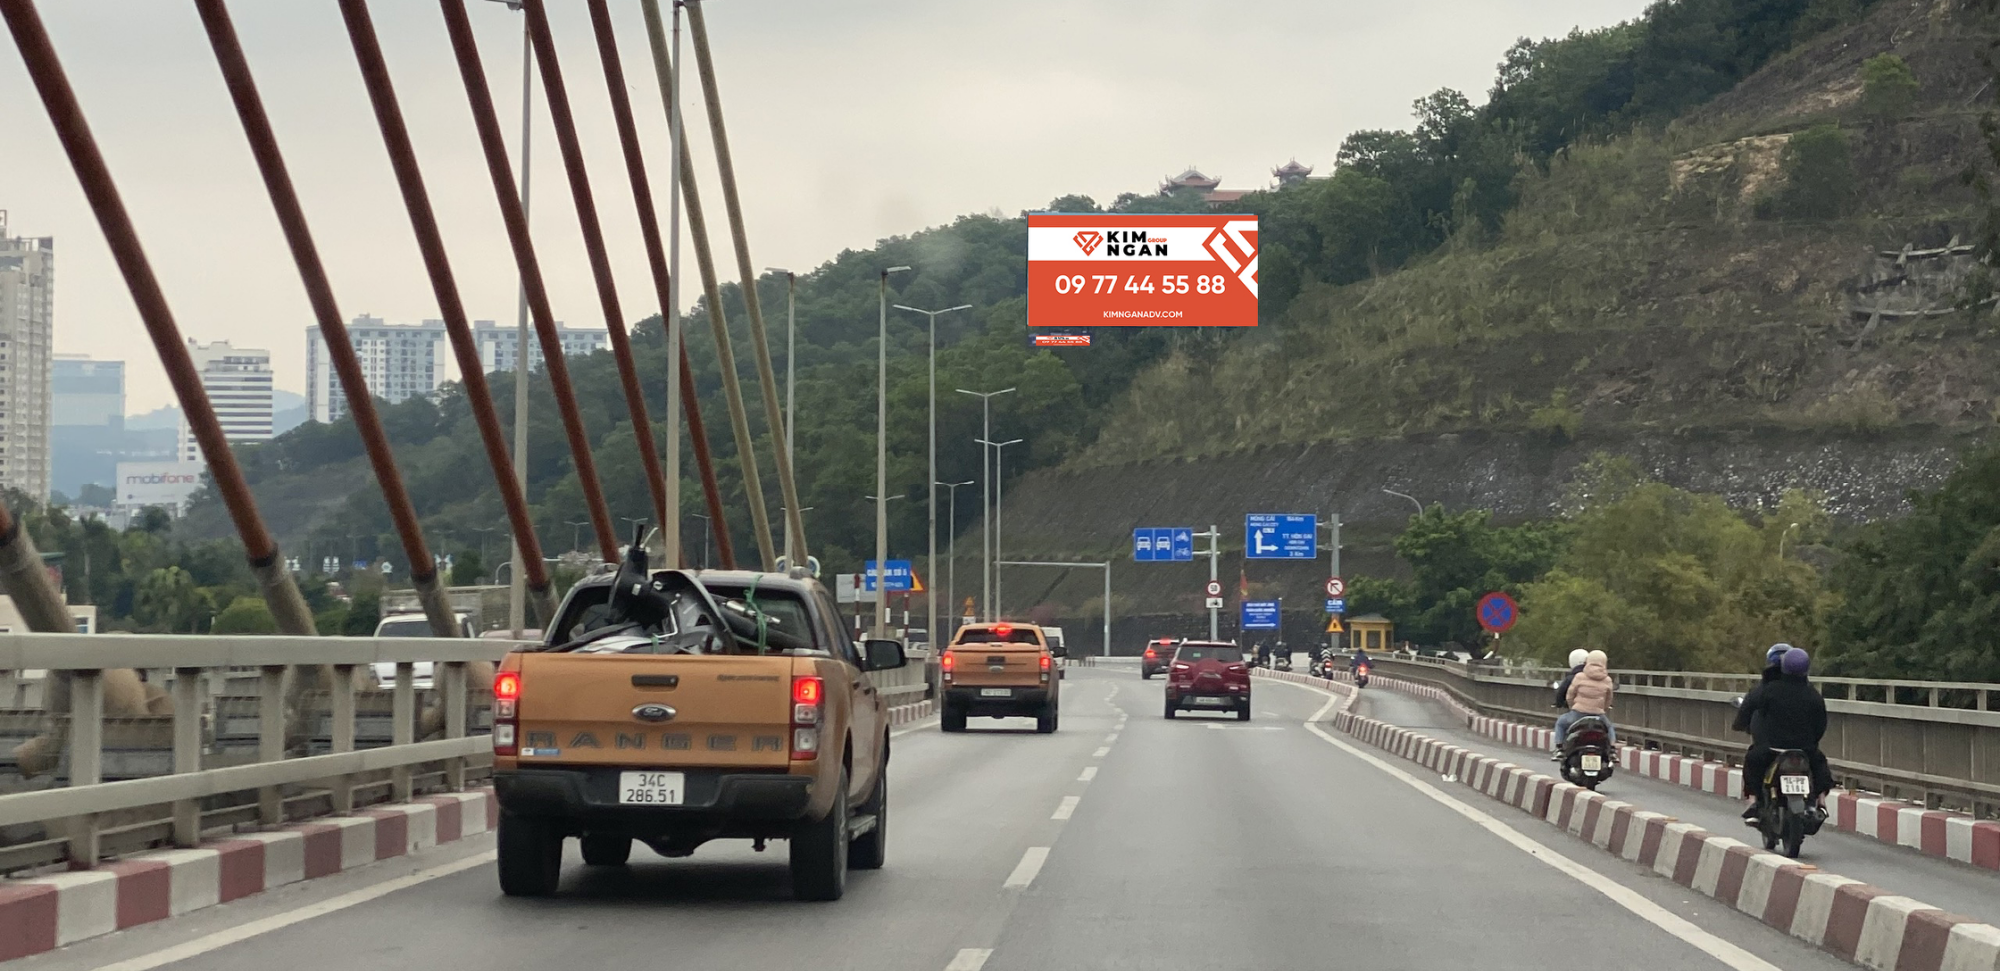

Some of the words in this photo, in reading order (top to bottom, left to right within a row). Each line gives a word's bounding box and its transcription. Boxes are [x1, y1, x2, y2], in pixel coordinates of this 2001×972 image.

[1107, 231, 1147, 243] KIM
[1107, 244, 1168, 256] NGAN
[1055, 275, 1085, 294] 09
[1092, 275, 1118, 294] 77
[1124, 275, 1155, 294] 44
[1161, 275, 1189, 294] 55
[1196, 275, 1225, 294] 88
[1103, 310, 1183, 318] KIMNGANADV.COM
[126, 473, 194, 484] mobifone
[527, 732, 781, 752] RANGER
[638, 774, 665, 787] 34C
[626, 789, 675, 803] 286.51
